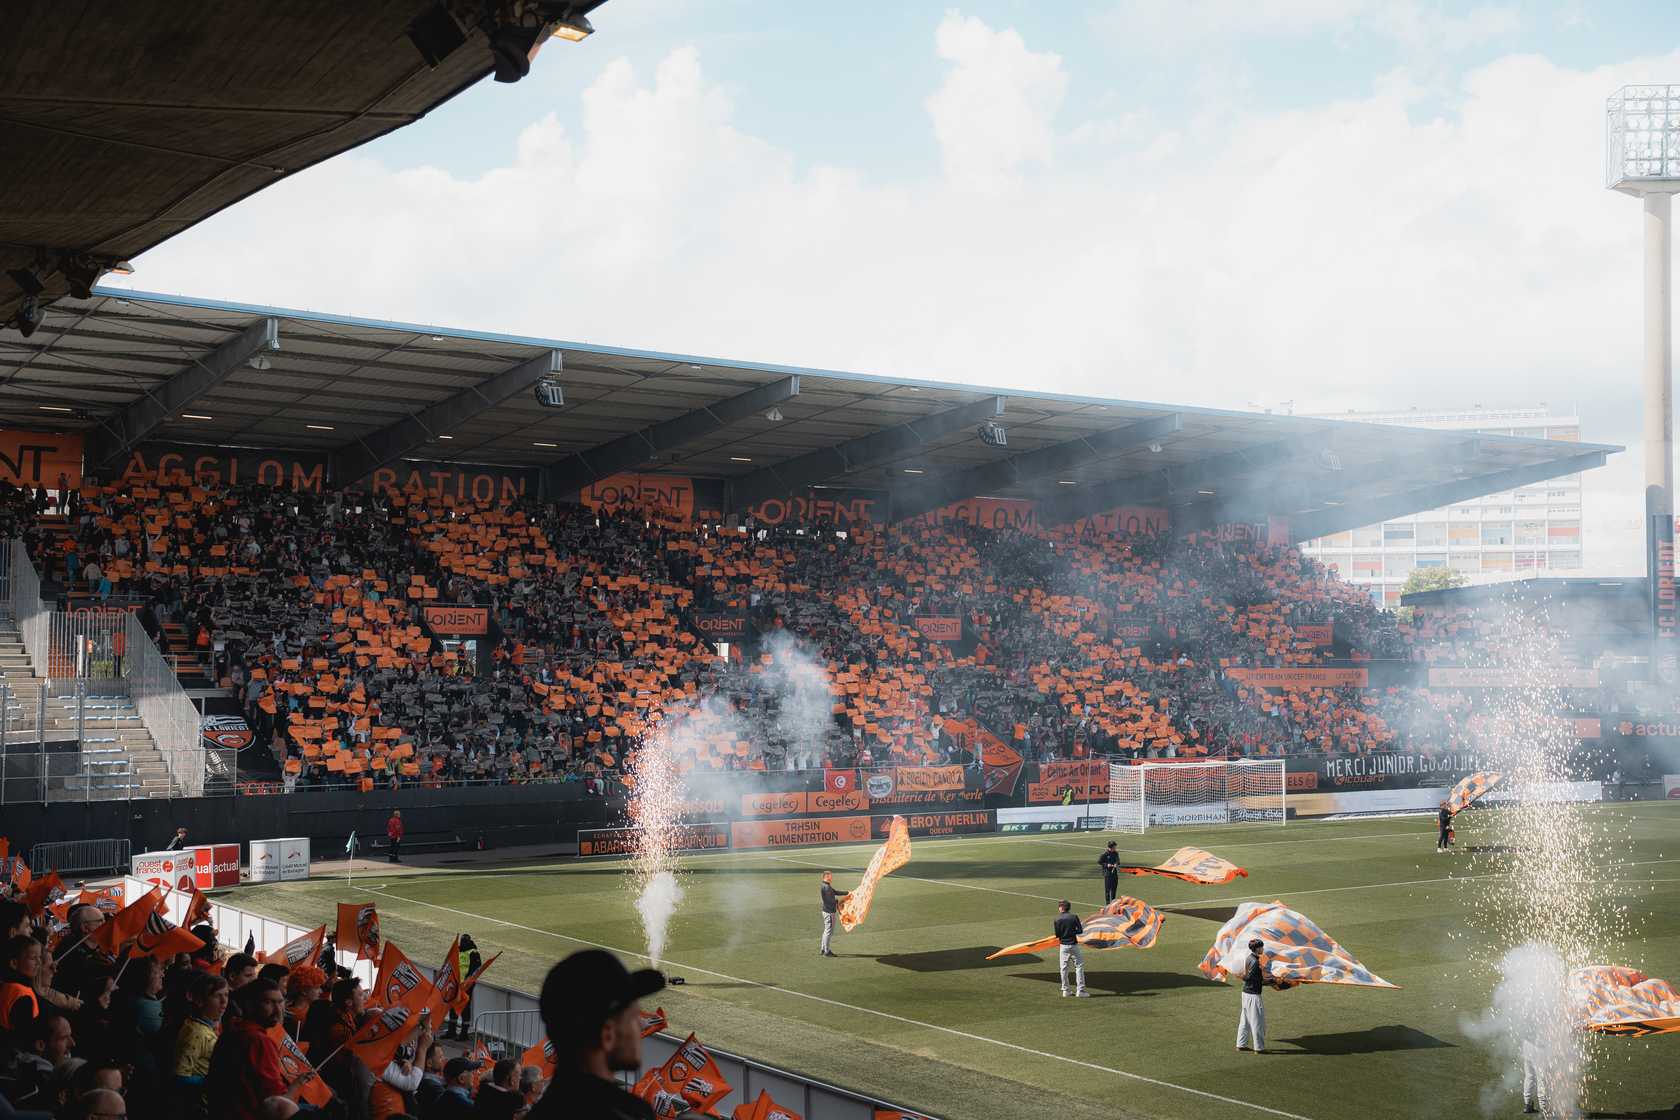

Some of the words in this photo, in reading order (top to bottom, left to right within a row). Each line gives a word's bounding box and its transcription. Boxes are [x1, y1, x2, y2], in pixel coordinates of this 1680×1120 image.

[1657, 539, 1676, 610] LORIENT
[426, 609, 485, 626] LORIENT
[695, 615, 746, 632] LORIENT
[1657, 612, 1676, 639] FC
[917, 619, 960, 634] LORIENT
[1326, 757, 1366, 777] MERCI
[752, 796, 799, 814] Cegelec
[815, 796, 860, 812] Cegelec
[785, 820, 821, 831] TAHSIN
[903, 816, 939, 829] LEROY
[943, 812, 989, 826] MERLIN
[767, 831, 839, 845] ALIMENTATION
[213, 860, 239, 873] actual
